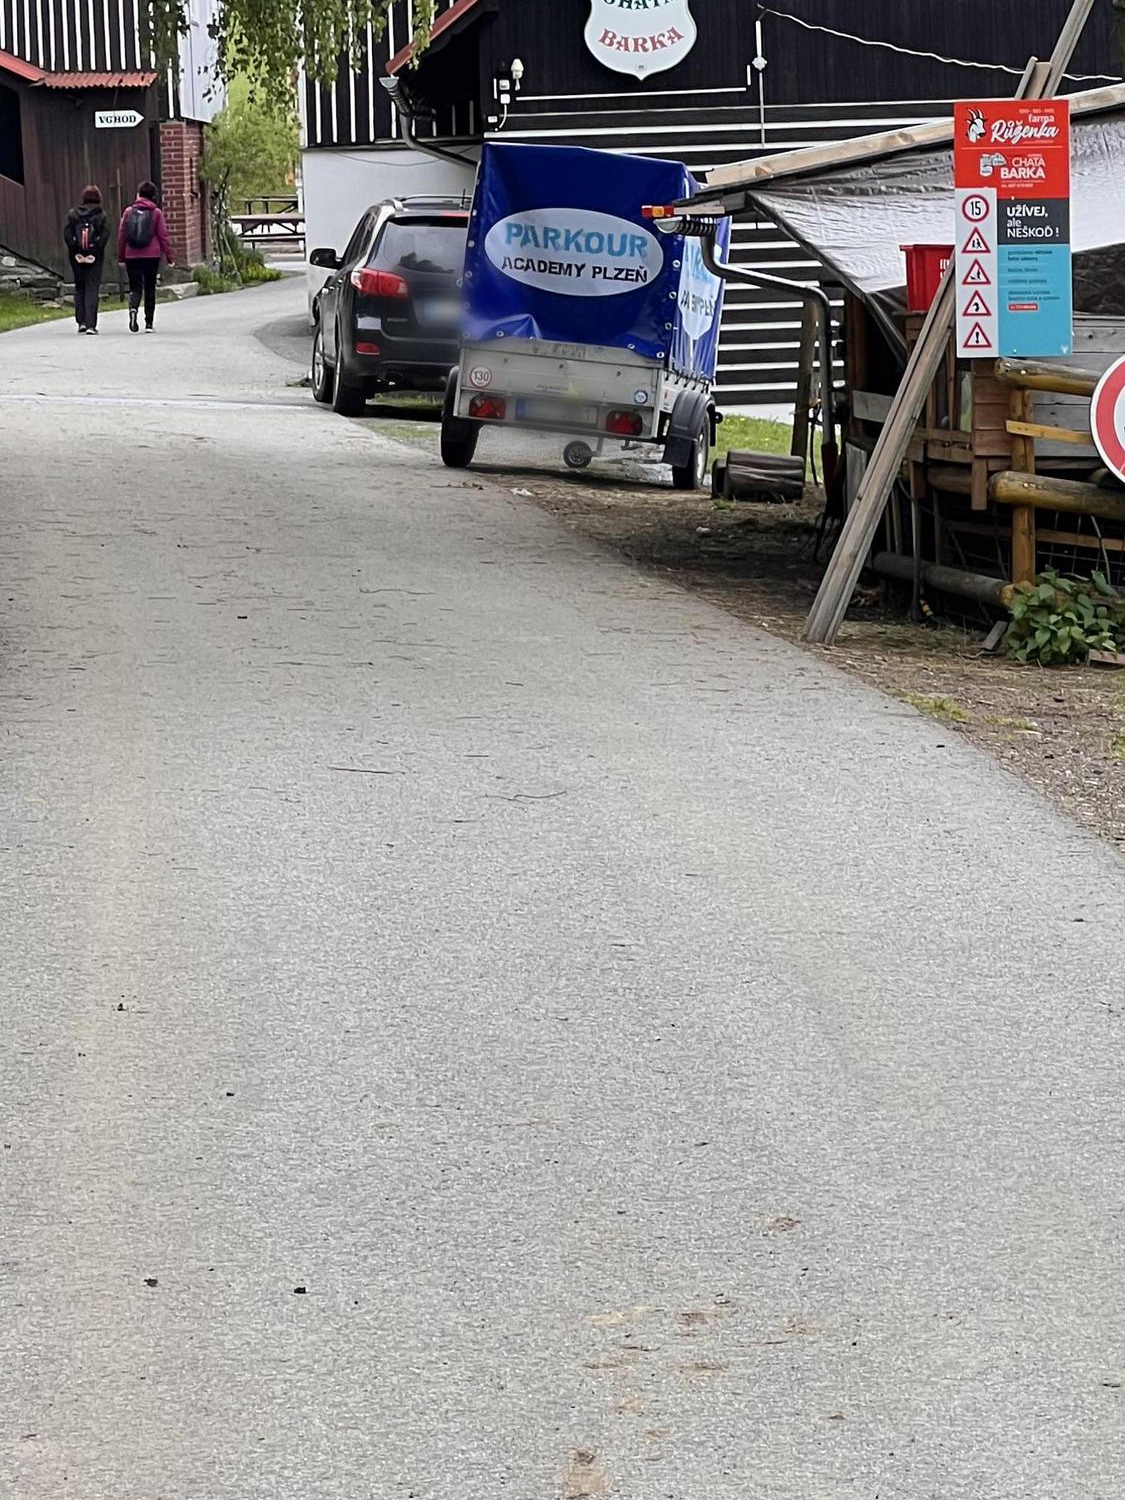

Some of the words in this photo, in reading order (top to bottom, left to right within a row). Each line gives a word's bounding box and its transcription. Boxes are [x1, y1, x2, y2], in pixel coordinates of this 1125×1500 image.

[598, 26, 684, 53] BARKA
[1028, 113, 1055, 123] farma
[990, 119, 1060, 145] Růženka
[1012, 157, 1046, 168] CHATA
[1000, 167, 1047, 179] BARKA
[970, 200, 982, 217] 15
[1006, 204, 1049, 218] UŽÍVEJ,
[1006, 217, 1022, 228] ale
[505, 222, 648, 258] PARKOUR
[501, 256, 587, 278] ACADEMY
[591, 265, 648, 283] PLZEŇ
[474, 370, 490, 382] 130
